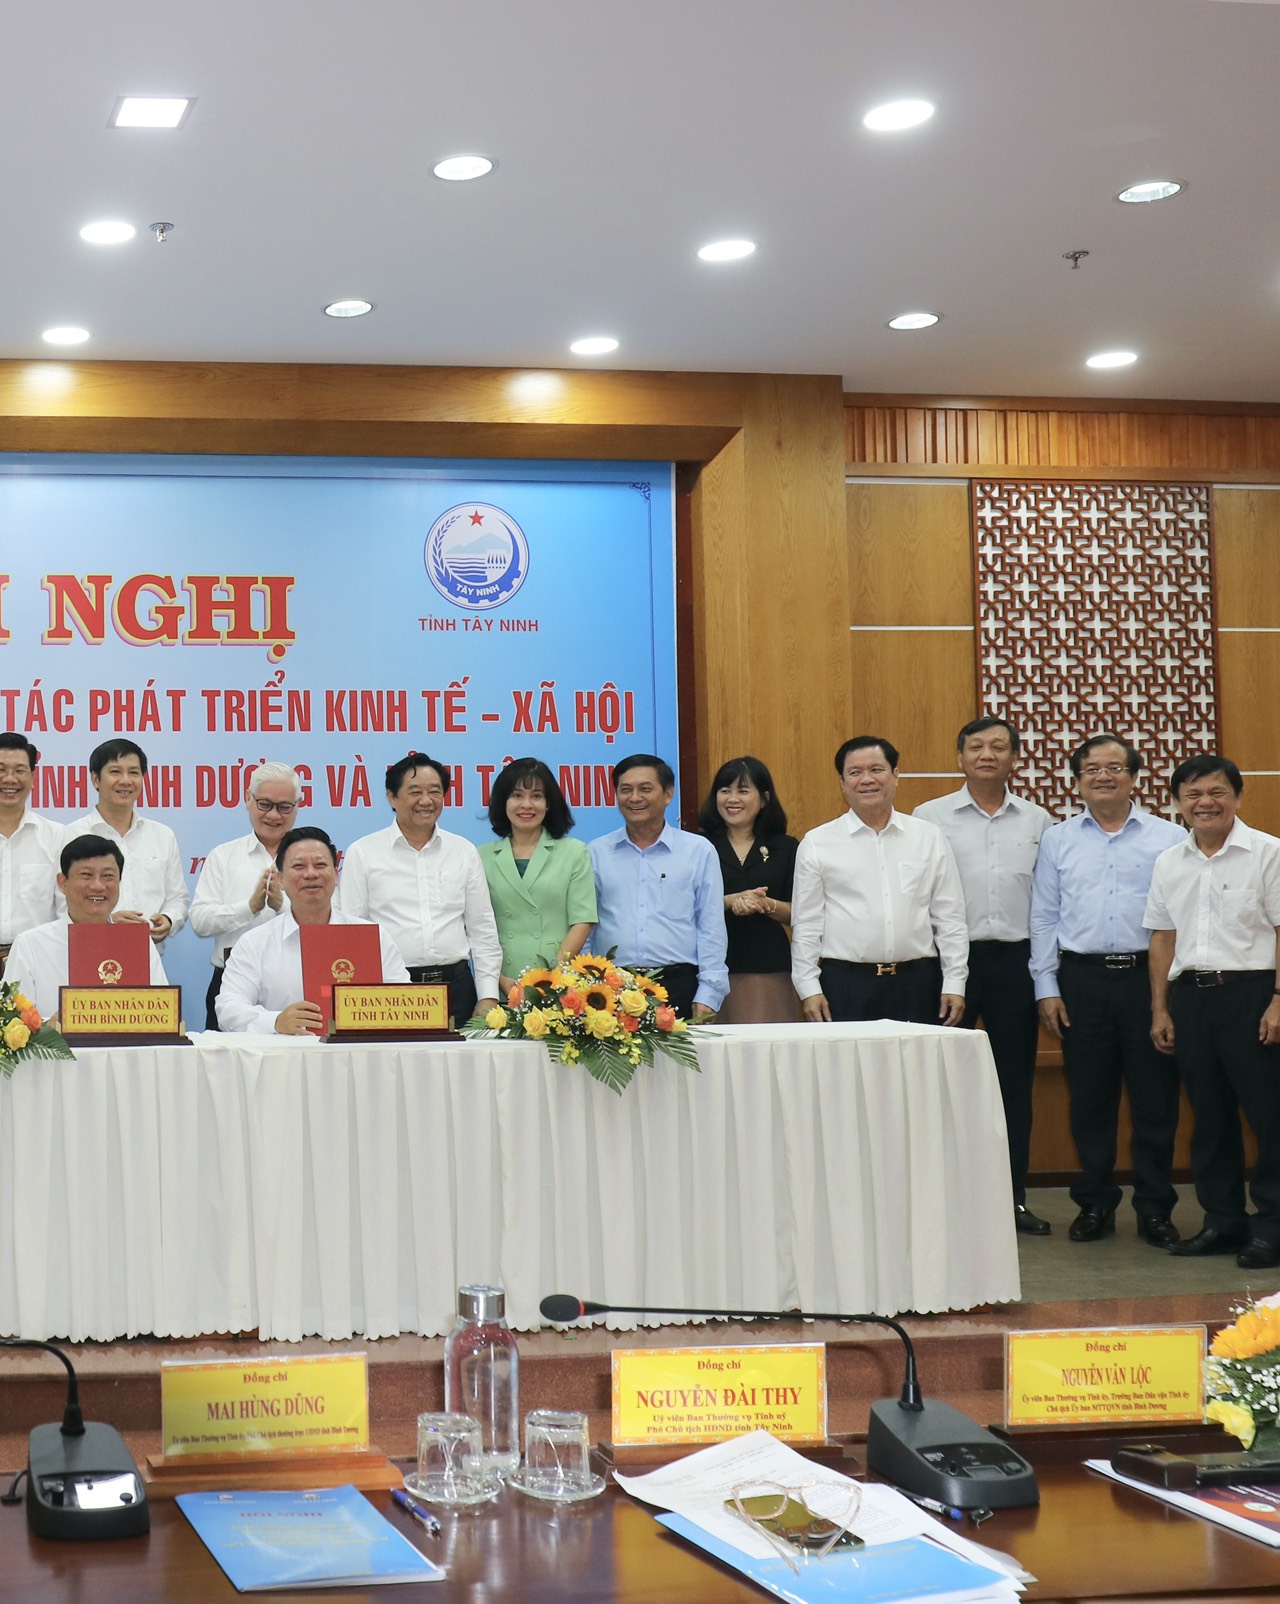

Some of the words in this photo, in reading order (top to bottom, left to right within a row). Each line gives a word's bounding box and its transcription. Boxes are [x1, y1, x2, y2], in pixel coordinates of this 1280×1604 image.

[456, 583, 474, 596] TÂY
[476, 584, 500, 596] NINH
[41, 573, 297, 664] NGHỊ
[418, 614, 456, 631] TỈNH
[461, 615, 494, 632] TÂY
[500, 619, 539, 632] NINH
[2, 678, 75, 732] TÁC
[90, 679, 187, 732] PHÁT
[202, 670, 312, 733] TRIỂN
[324, 690, 407, 733] KINH
[422, 676, 471, 733] TẾ
[512, 680, 563, 733] XÃ
[575, 682, 635, 744] HỘI
[31, 751, 87, 808] ỈNH
[137, 765, 181, 807] NH
[196, 758, 312, 807] DƯG
[326, 754, 371, 807] VÀ
[559, 765, 617, 807] NIN
[72, 998, 87, 1010] ỦY
[90, 1000, 111, 1010] BAN
[114, 998, 144, 1010] NHÂN
[147, 998, 169, 1010] DÂN
[344, 995, 358, 1007] ỦY
[361, 998, 382, 1007] BAN
[384, 994, 414, 1006] NHÂN
[417, 994, 439, 1006] DÂN
[71, 1012, 97, 1024] TỈNH
[100, 1012, 126, 1024] BÌNH
[129, 1013, 169, 1024] DƯƠNG
[351, 1009, 377, 1021] TỈNH
[380, 1008, 400, 1021] TÂY
[403, 1011, 429, 1020] NINH
[1085, 1341, 1111, 1353] Đồng
[1113, 1342, 1127, 1351] chí
[697, 1360, 724, 1371] Đồng
[726, 1359, 741, 1370] chí
[243, 1373, 270, 1384] Đồng
[273, 1372, 288, 1382] chí
[1062, 1363, 1103, 1387] NGUYỄN
[1105, 1363, 1126, 1385] VĂN
[1130, 1364, 1152, 1389] LỘC
[636, 1384, 717, 1409] NGUYỄN
[723, 1383, 757, 1407] ĐÀI
[762, 1387, 802, 1406] THY
[207, 1402, 235, 1421] MAI
[240, 1395, 280, 1419] HÙNG
[285, 1393, 325, 1416] DŨNG
